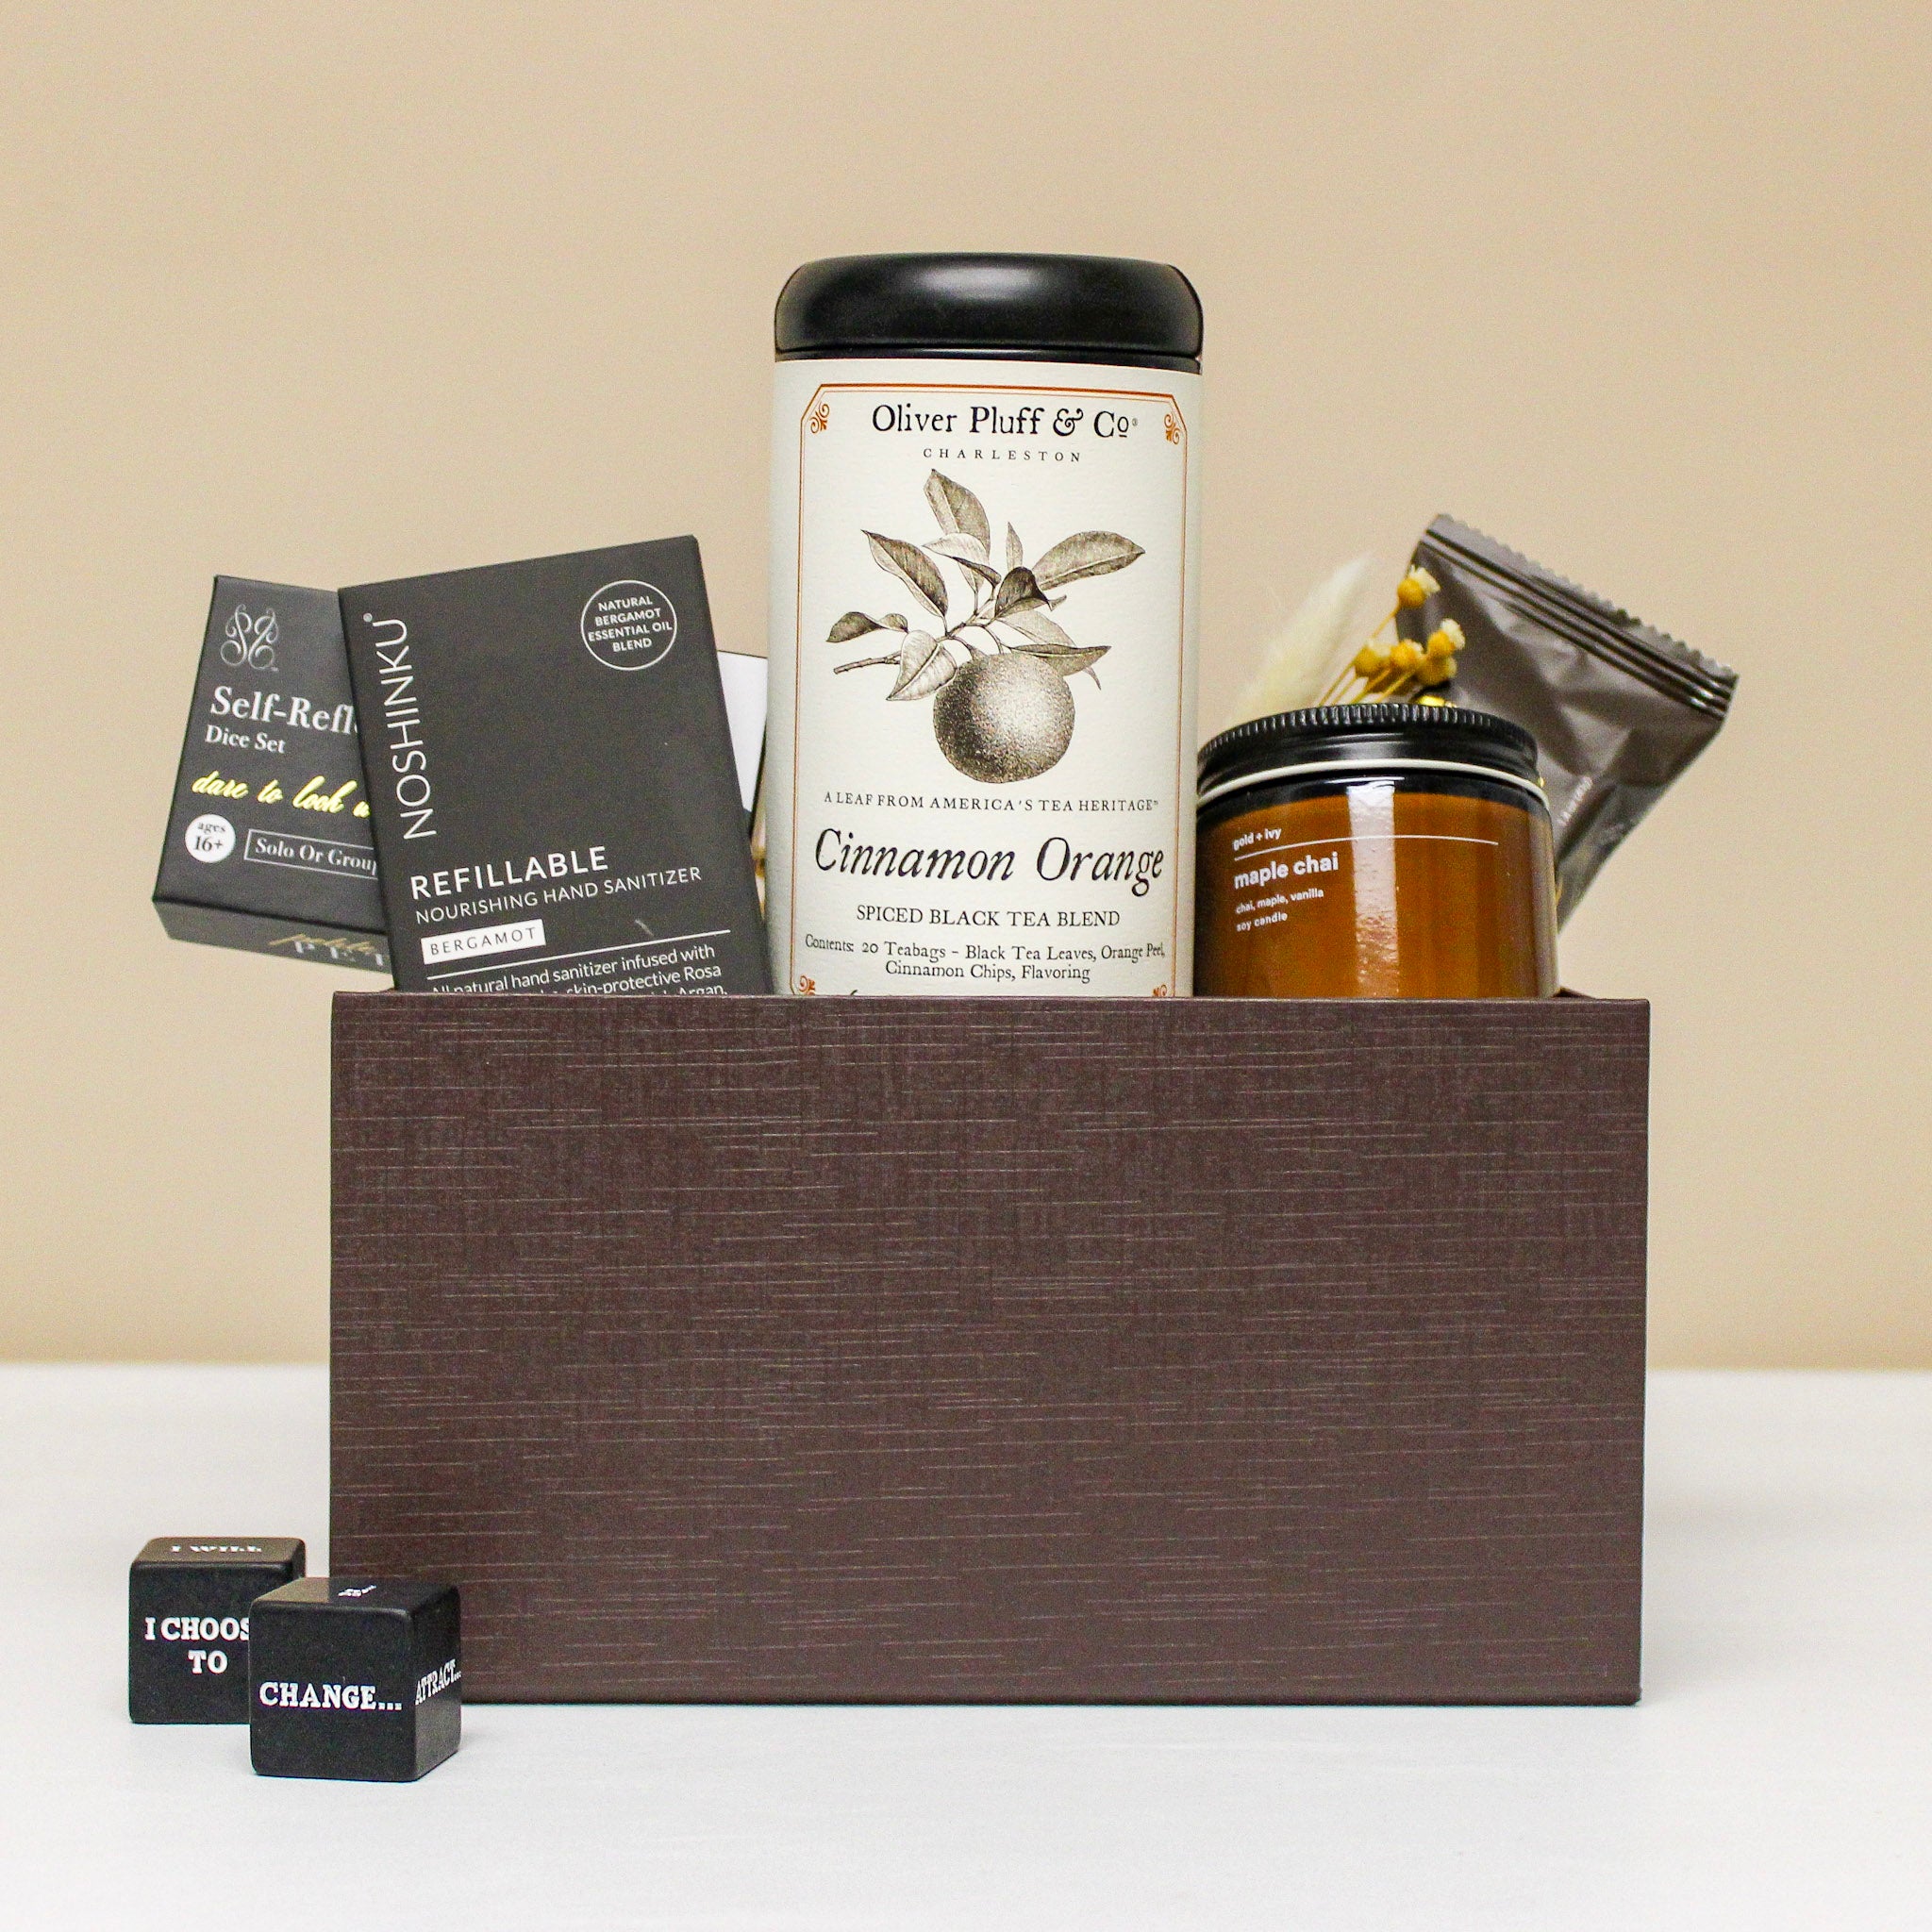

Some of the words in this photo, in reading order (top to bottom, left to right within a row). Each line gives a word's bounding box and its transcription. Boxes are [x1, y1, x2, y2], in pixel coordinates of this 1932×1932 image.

[873, 403, 958, 432] Oliver
[970, 406, 1045, 435] Pluff
[1053, 408, 1084, 437] &
[923, 448, 1080, 462] CHARLESTON
[598, 595, 653, 611] NATURAL
[594, 608, 661, 627] BERGAMOT
[588, 625, 650, 641] ESSENTIAL
[652, 621, 673, 633] OIL
[612, 638, 652, 652] BLEND
[209, 685, 358, 735] Self-Refl
[205, 724, 250, 748] Dice
[254, 731, 286, 754] Set
[192, 770, 249, 800] dare
[257, 778, 283, 804] to
[292, 774, 358, 814] look
[824, 791, 832, 803] A
[837, 791, 874, 806] LEAF
[877, 794, 924, 808] FROM
[929, 797, 1033, 811] AMERICA'S
[1038, 799, 1074, 811] TEA
[196, 822, 226, 834] ages
[194, 834, 224, 853] 16+
[256, 837, 294, 858] Solo
[300, 844, 324, 863] Or
[1233, 832, 1254, 851] gold
[410, 845, 608, 900] REFILLABLE
[815, 827, 1015, 881] Cinnamon
[1037, 837, 1164, 897] Orange
[1234, 860, 1289, 890] maple
[1293, 851, 1339, 875] chai
[415, 891, 538, 924] NOURISHING
[543, 881, 598, 904] HAND
[605, 866, 702, 893] SANITIZER
[1291, 888, 1324, 901] vanilla
[856, 904, 924, 923] SPICED
[929, 908, 1000, 926] BLACK
[1007, 910, 1050, 926] TEA
[1057, 910, 1121, 926] BLEND
[1237, 921, 1251, 932] soy
[1254, 911, 1288, 927] candle
[430, 927, 536, 956] BERGAMOT
[805, 933, 854, 952] Contents:
[861, 942, 879, 954] 20
[884, 941, 946, 963] Teabags
[965, 944, 1006, 959] Black
[1011, 945, 1041, 960] Tea
[1046, 945, 1097, 962] Leaves,
[1101, 944, 1143, 963] Orange
[511, 969, 549, 989] hand
[552, 961, 618, 982] sanitizer
[621, 948, 677, 971] infused
[680, 943, 715, 961] with
[684, 965, 722, 982] Rosa
[886, 959, 964, 977] Cinnamon
[970, 963, 1016, 982] Chips,
[1022, 963, 1091, 984] Flavoring
[144, 1616, 156, 1641] I
[188, 1650, 228, 1674] TO
